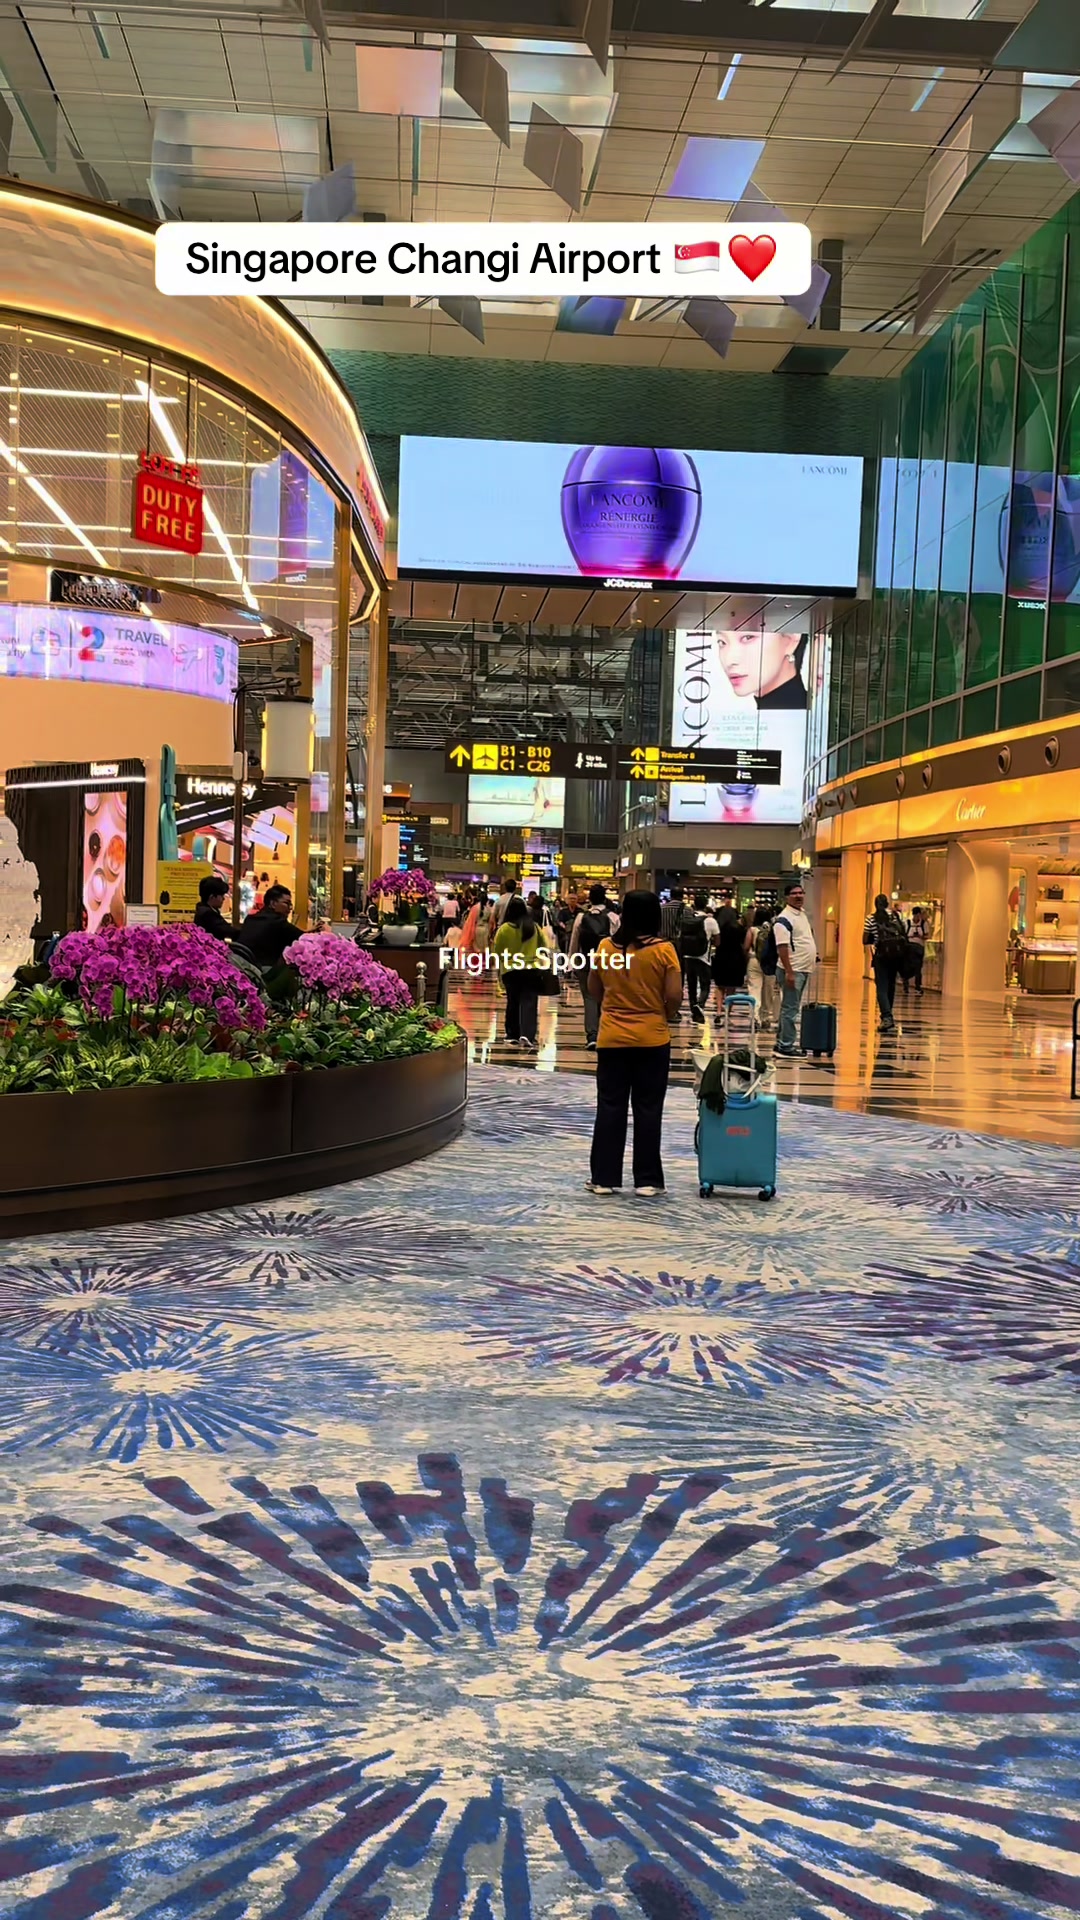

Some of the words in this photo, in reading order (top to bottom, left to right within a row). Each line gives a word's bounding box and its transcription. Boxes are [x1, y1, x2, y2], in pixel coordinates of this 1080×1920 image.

[142, 483, 198, 518] DUTY
[141, 509, 196, 543] FREE
[78, 626, 106, 663] 2
[114, 627, 169, 647] TRAVEL
[500, 745, 515, 757] B1
[527, 746, 551, 758] B10
[500, 759, 515, 771] C1
[526, 760, 551, 773] C26
[955, 797, 987, 821] Cartier
